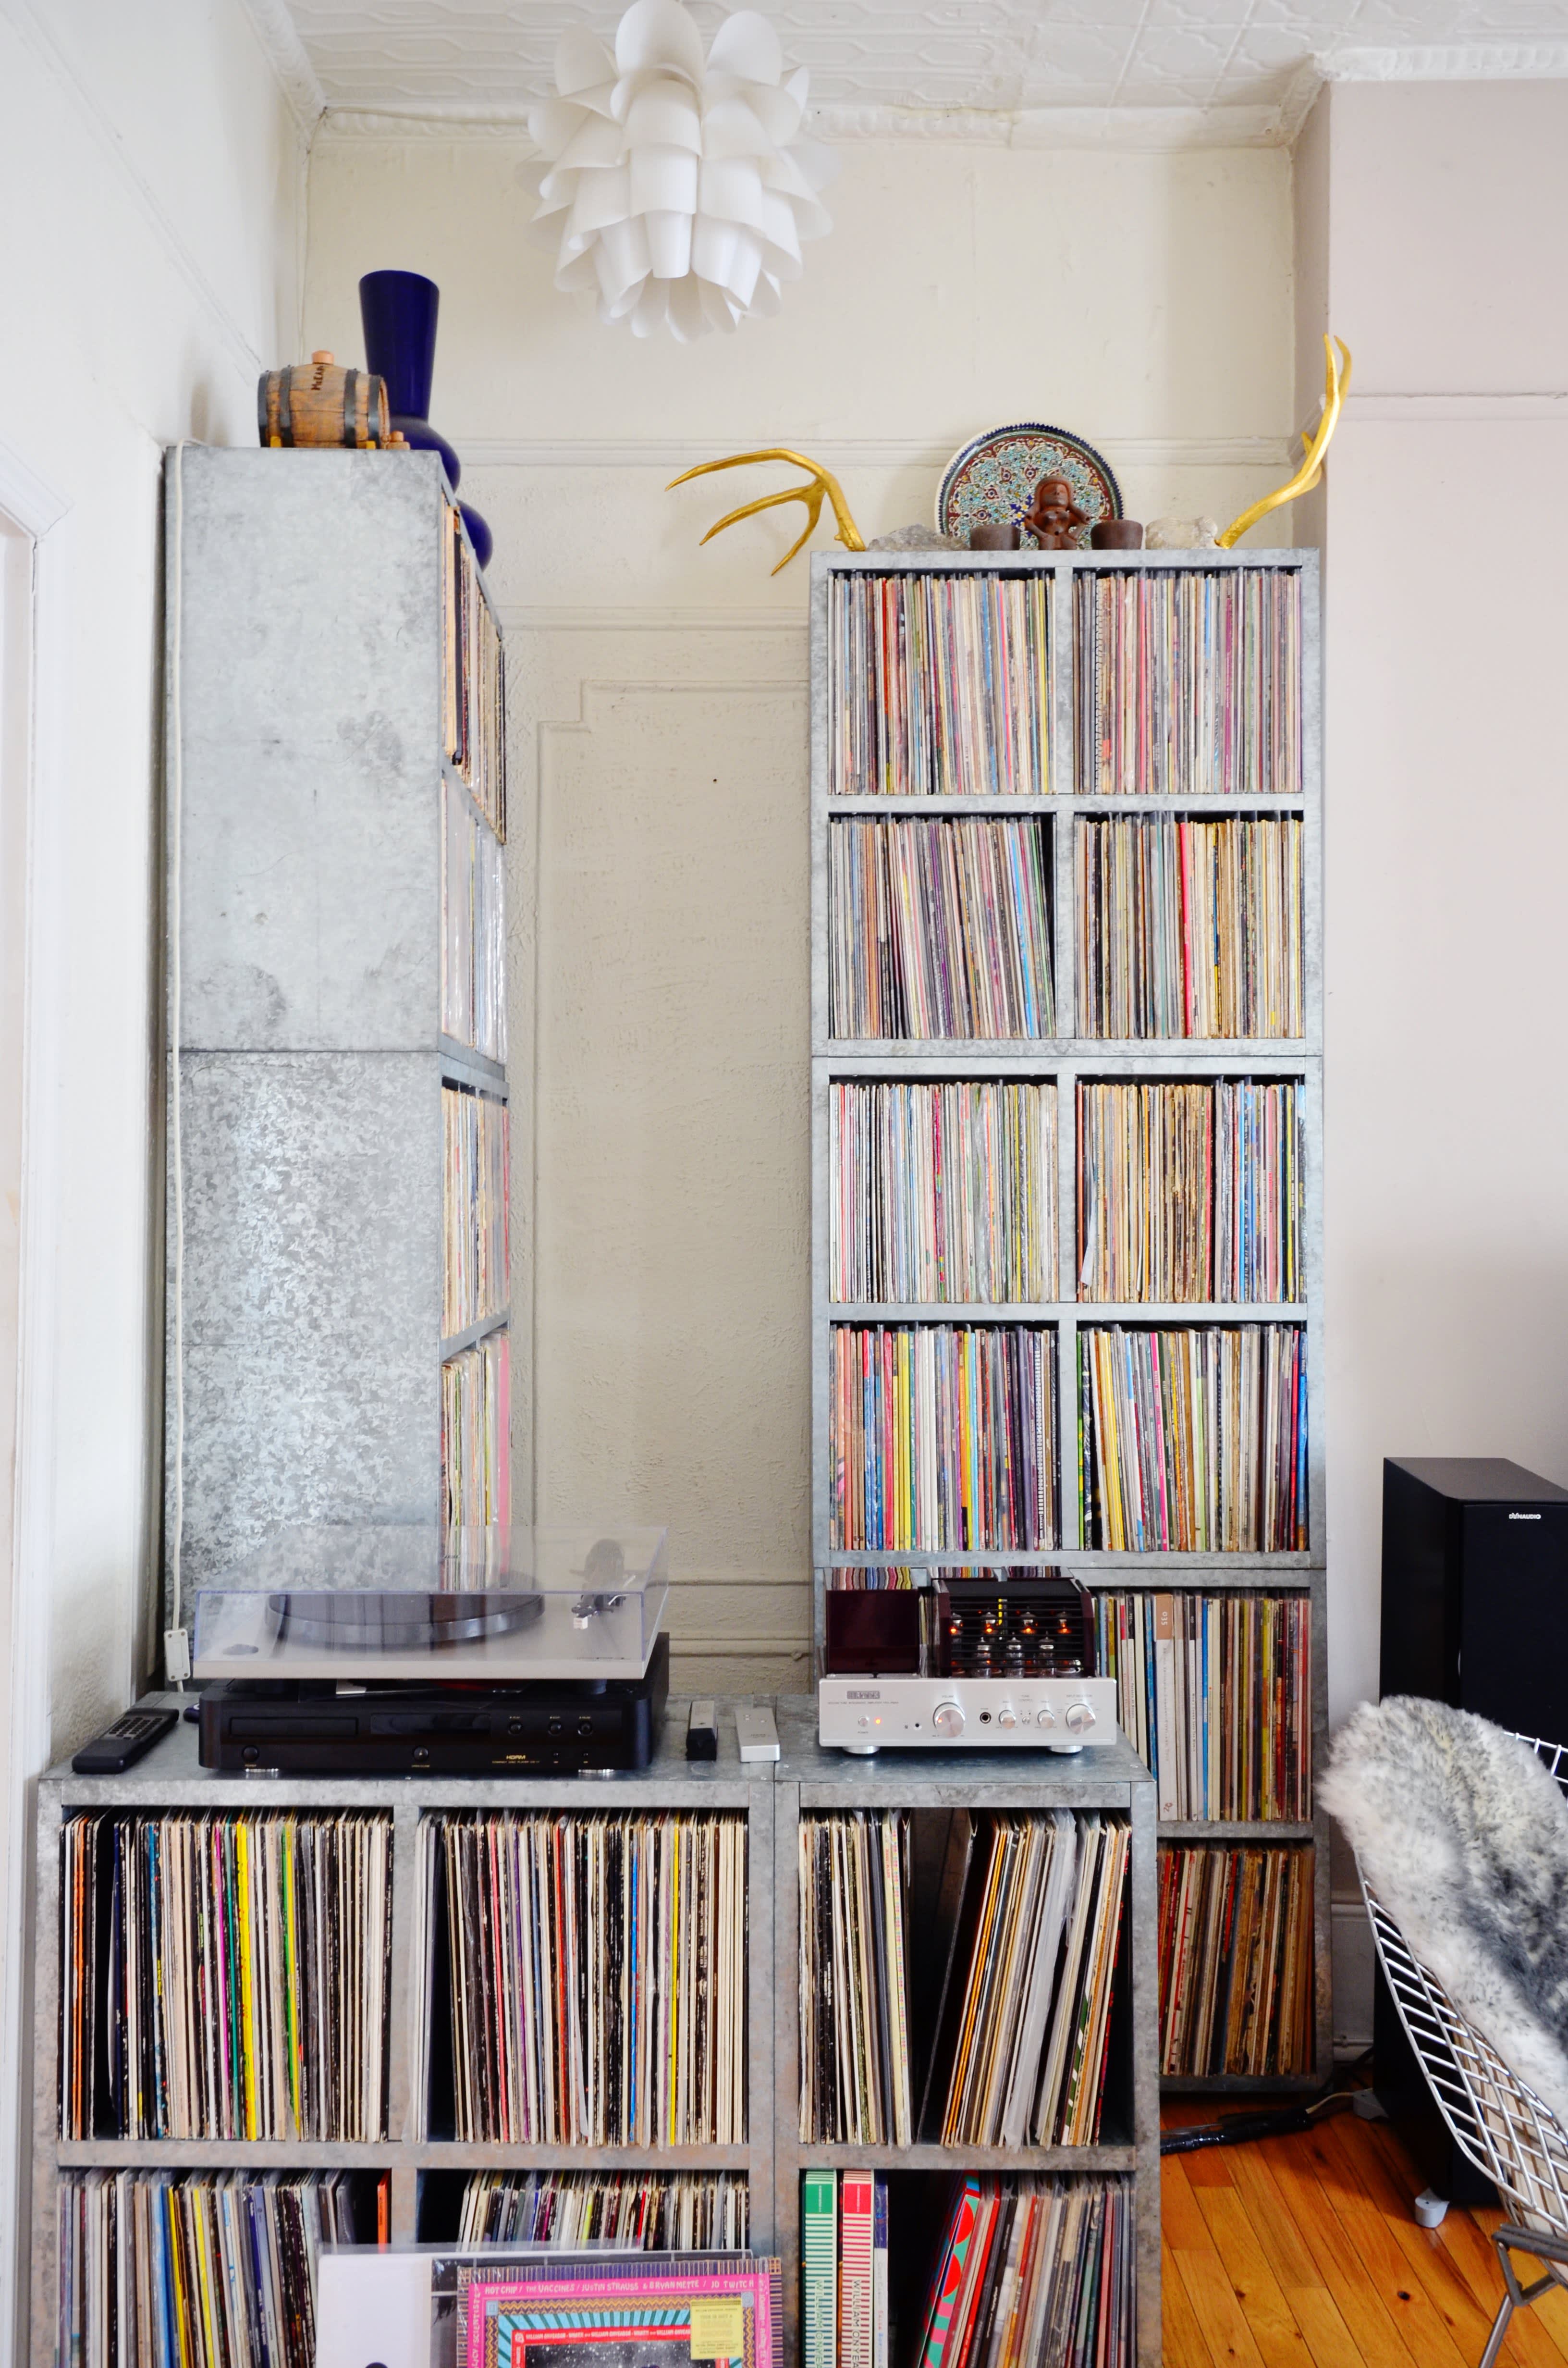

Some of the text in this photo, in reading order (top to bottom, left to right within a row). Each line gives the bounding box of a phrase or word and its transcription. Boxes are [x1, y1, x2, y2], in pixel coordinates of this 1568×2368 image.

[485, 2286, 499, 2294] HOT
[538, 2283, 575, 2293] VACCINES
[582, 2282, 605, 2292] JUSTIN
[607, 2282, 638, 2291] STRAUSS
[649, 2281, 675, 2290] BRYAN
[711, 2281, 720, 2289] JD
[723, 2280, 754, 2289] TWITCH
[852, 2280, 860, 2327] WILLIAM
